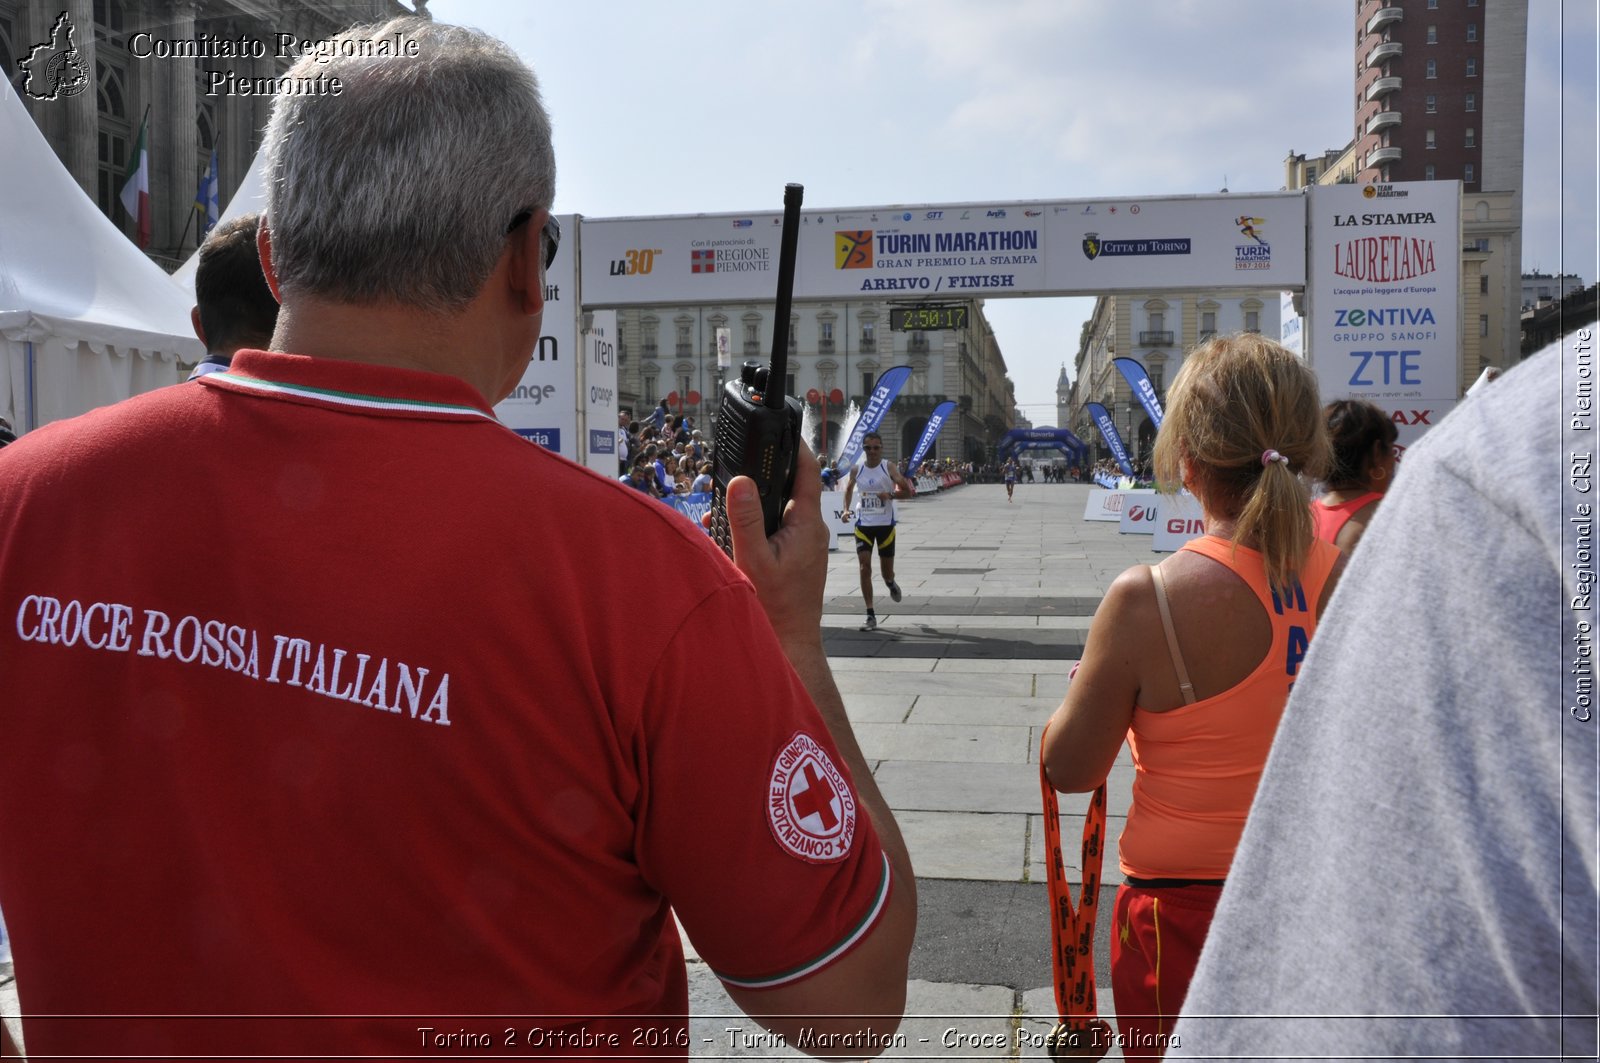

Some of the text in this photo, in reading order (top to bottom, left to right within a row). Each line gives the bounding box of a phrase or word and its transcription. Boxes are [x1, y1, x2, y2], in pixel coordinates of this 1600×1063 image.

[926, 211, 944, 220] GTT
[1334, 213, 1436, 226] LA STAMPA
[691, 240, 705, 248] Con
[711, 239, 746, 249] patrocinio
[877, 230, 1038, 254] TURIN MARATHON
[1137, 243, 1148, 252] DI
[1150, 240, 1188, 252] TORINO
[716, 248, 770, 262] REGIONE
[1235, 246, 1271, 256] TURIN
[1334, 236, 1436, 283] LAURETANA
[716, 261, 770, 273] PIEMONTE
[877, 254, 1038, 269] GRAN PREMIO LA STAMPA
[860, 276, 930, 291] ARRIVO
[947, 274, 1014, 289] FINISH
[1333, 286, 1437, 296] L'acqua più leggera d'Europa
[903, 308, 965, 329] 2:50:17
[1333, 331, 1437, 342] GRUPPO SANOFI
[594, 338, 614, 367] iren
[1348, 350, 1422, 386] ZTE
[845, 384, 891, 456] Bavaria
[913, 413, 942, 462] Bavaria
[17, 594, 451, 726] CROCE ROSSA ITALIANA
[774, 768, 788, 785] DI
[820, 755, 855, 811] AGOSTO
[771, 787, 833, 857] CONVENZIONE
